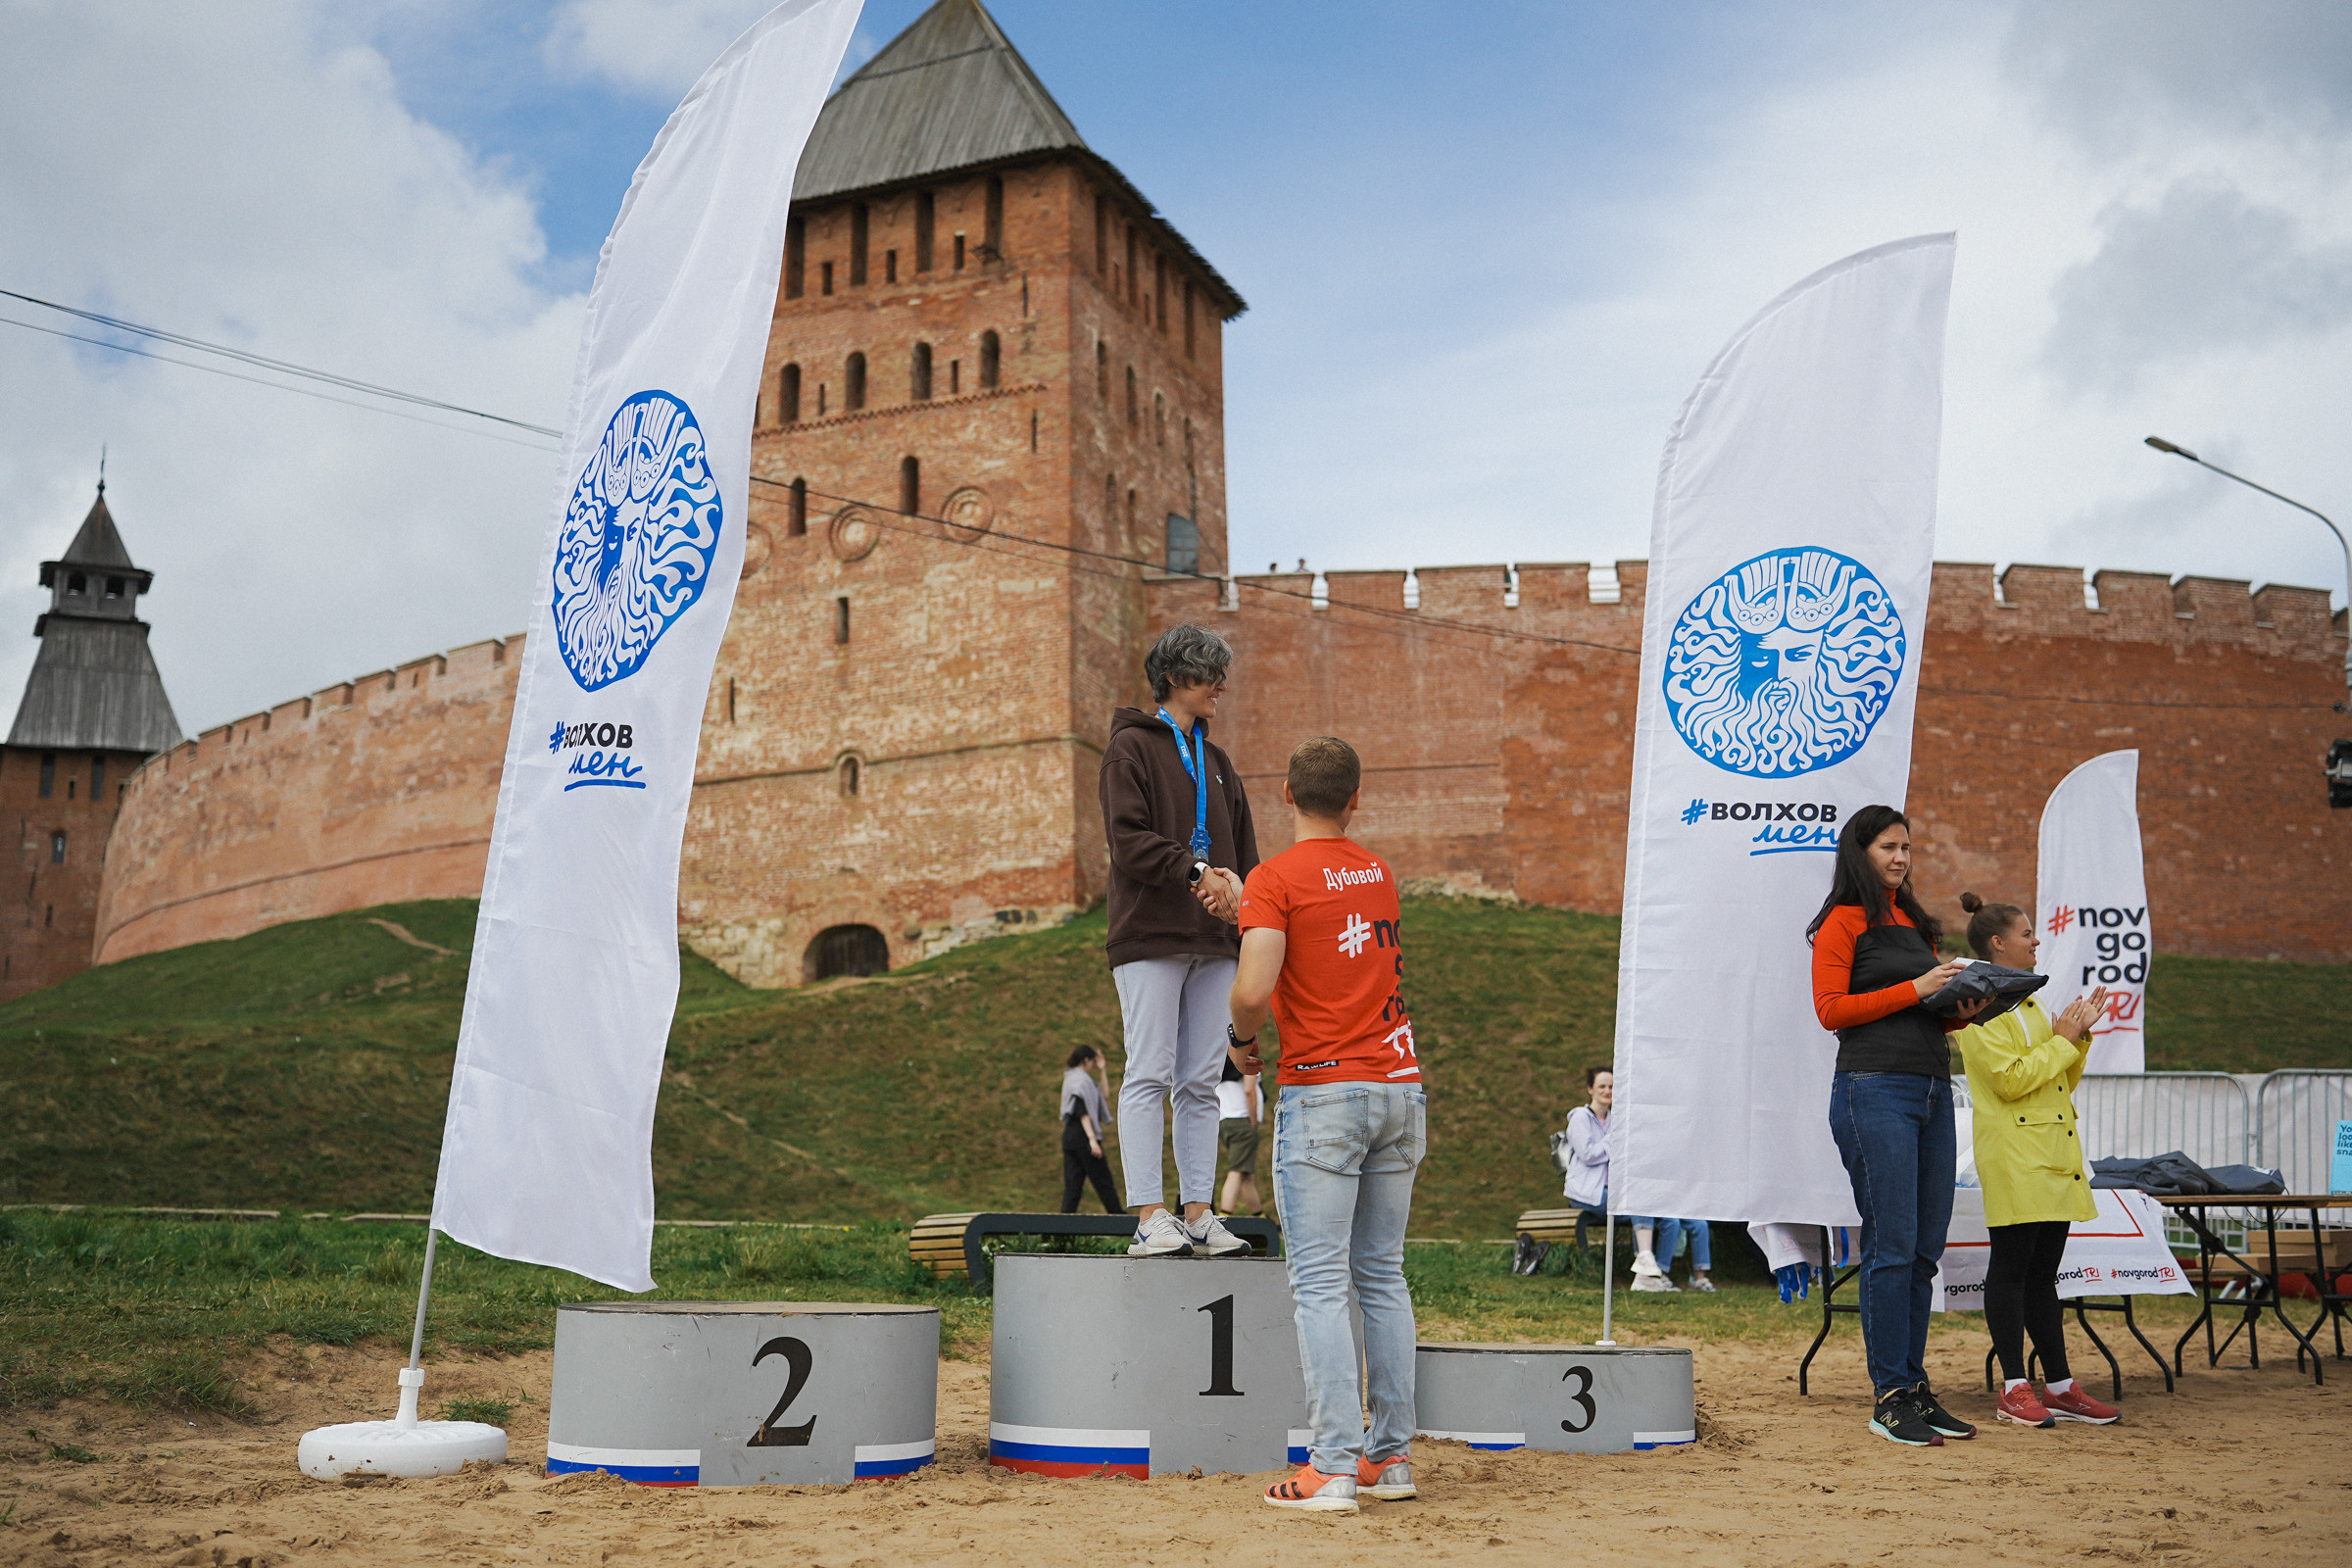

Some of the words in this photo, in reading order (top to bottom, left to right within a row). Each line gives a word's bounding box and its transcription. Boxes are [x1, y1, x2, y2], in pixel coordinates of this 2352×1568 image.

[549, 721, 633, 755] #ВОЛХОВ
[1681, 798, 1838, 825] #ВОЛХОВ
[1752, 824, 1839, 845] мен
[1322, 861, 1384, 892] Дубовой
[2048, 905, 2145, 936] #nov
[2096, 932, 2146, 961] go
[2082, 952, 2147, 986] rod
[2107, 991, 2141, 1022] RI
[1198, 1294, 1245, 1396] 1
[747, 1336, 817, 1447] 2
[1560, 1365, 1596, 1434] 3
